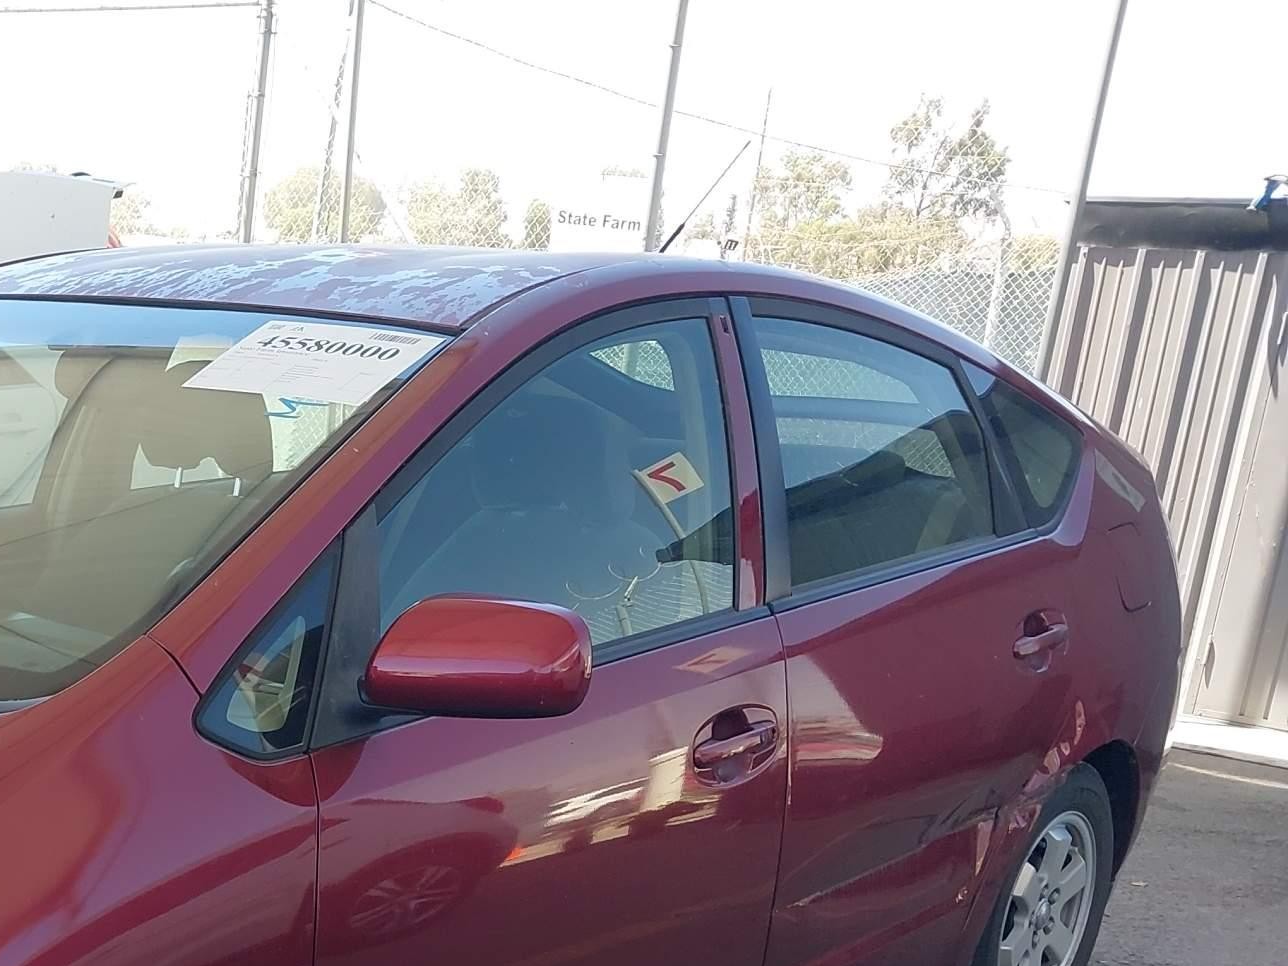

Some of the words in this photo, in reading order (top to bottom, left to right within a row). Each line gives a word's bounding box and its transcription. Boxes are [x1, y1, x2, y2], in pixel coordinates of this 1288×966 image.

[558, 210, 597, 227] State
[602, 214, 641, 231] Farm
[256, 335, 401, 361] 45580000
